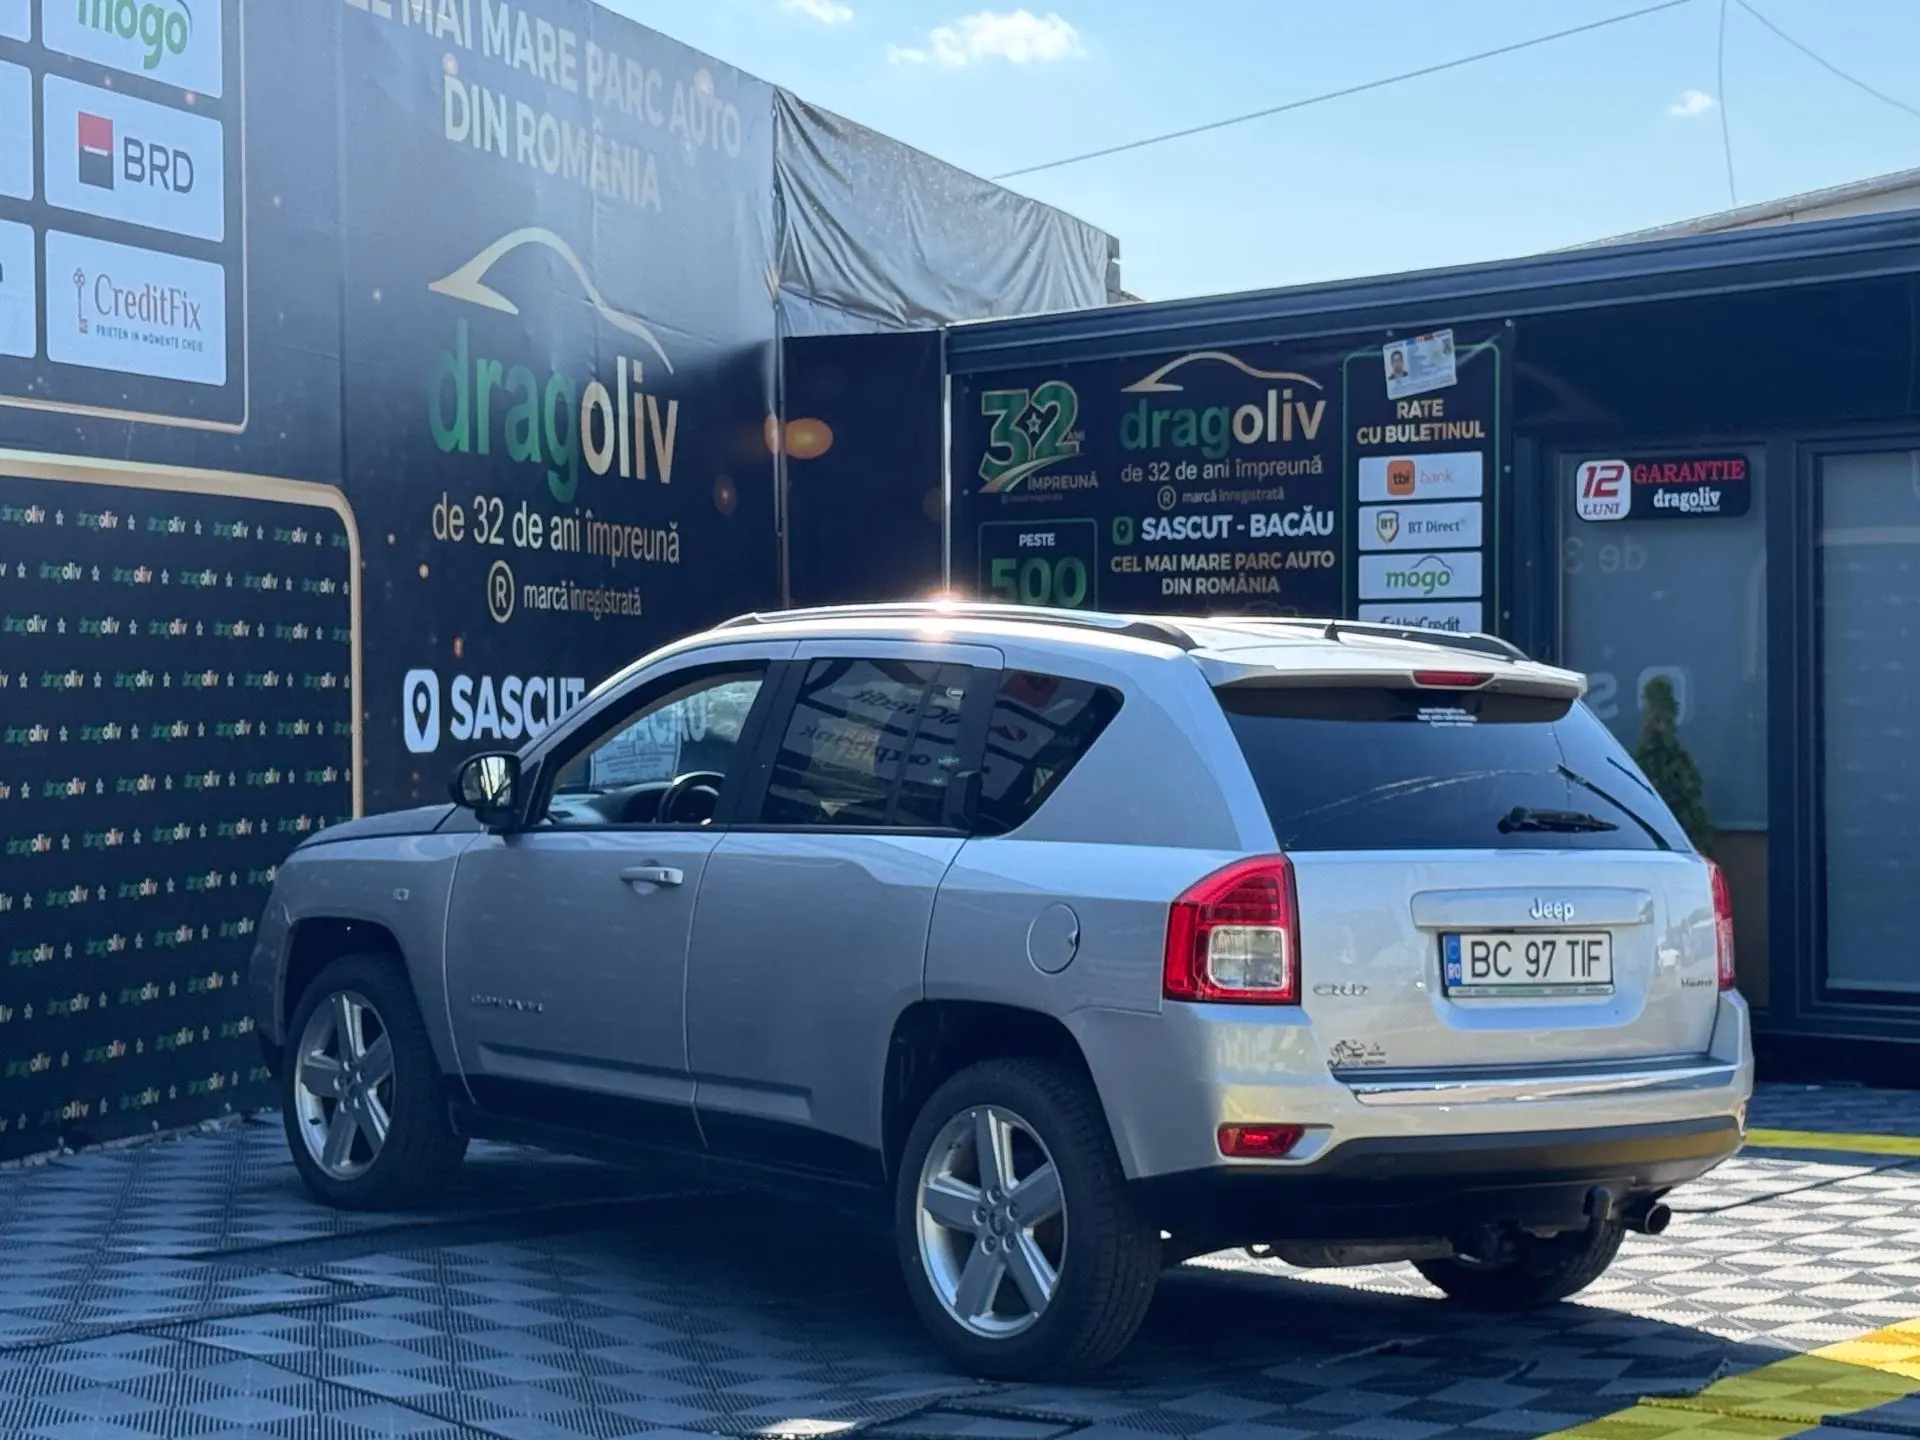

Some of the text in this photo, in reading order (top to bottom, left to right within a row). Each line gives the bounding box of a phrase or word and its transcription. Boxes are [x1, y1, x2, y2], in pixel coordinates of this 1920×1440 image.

[78, 0, 188, 69] mogo
[480, 0, 578, 93] MARE
[585, 40, 663, 128] PARC
[670, 80, 741, 158] AUTO
[444, 75, 662, 213] DIN ROMÂNIA
[123, 136, 194, 194] BRD
[94, 273, 201, 331] CreditFix
[96, 324, 129, 340] PRIETEN
[130, 329, 140, 341] IN
[142, 334, 179, 349] MOMENTE
[428, 318, 680, 503] dragoliv
[1396, 399, 1444, 419] RATE
[979, 381, 1079, 481] 32
[1120, 389, 1326, 459] dragoliv
[1357, 421, 1484, 445] CU BULETINUL
[1027, 470, 1099, 491] ÎMPREUNĂ
[1121, 455, 1323, 483] de 32 de ani împreună
[1393, 467, 1454, 485] tbi bank
[1582, 465, 1625, 498] 12
[1633, 460, 1745, 484] GARANTIE
[1182, 488, 1217, 504] marcă
[1654, 486, 1721, 512] dragoliv
[1583, 503, 1620, 516] LUNI
[433, 493, 680, 568] de 32 de ani împreună
[1142, 514, 1233, 541] SASCUT
[1250, 505, 1335, 538] BACĂU
[1380, 519, 1394, 530] BT
[1408, 520, 1460, 534] BT Direct
[1019, 532, 1055, 547] PESTE
[1111, 550, 1335, 573] CEL MAI MARE PARC AUTO
[991, 557, 1087, 608] 500
[1162, 574, 1280, 595] DIN ROMÂNIA
[1386, 570, 1451, 594] mogo
[524, 580, 567, 611] marcă
[570, 581, 642, 619] înregistrată
[450, 673, 586, 741] SASCUT
[1530, 898, 1575, 922] Jeep
[1448, 963, 1461, 980] RO
[1470, 940, 1603, 978] BC 97 TIF
